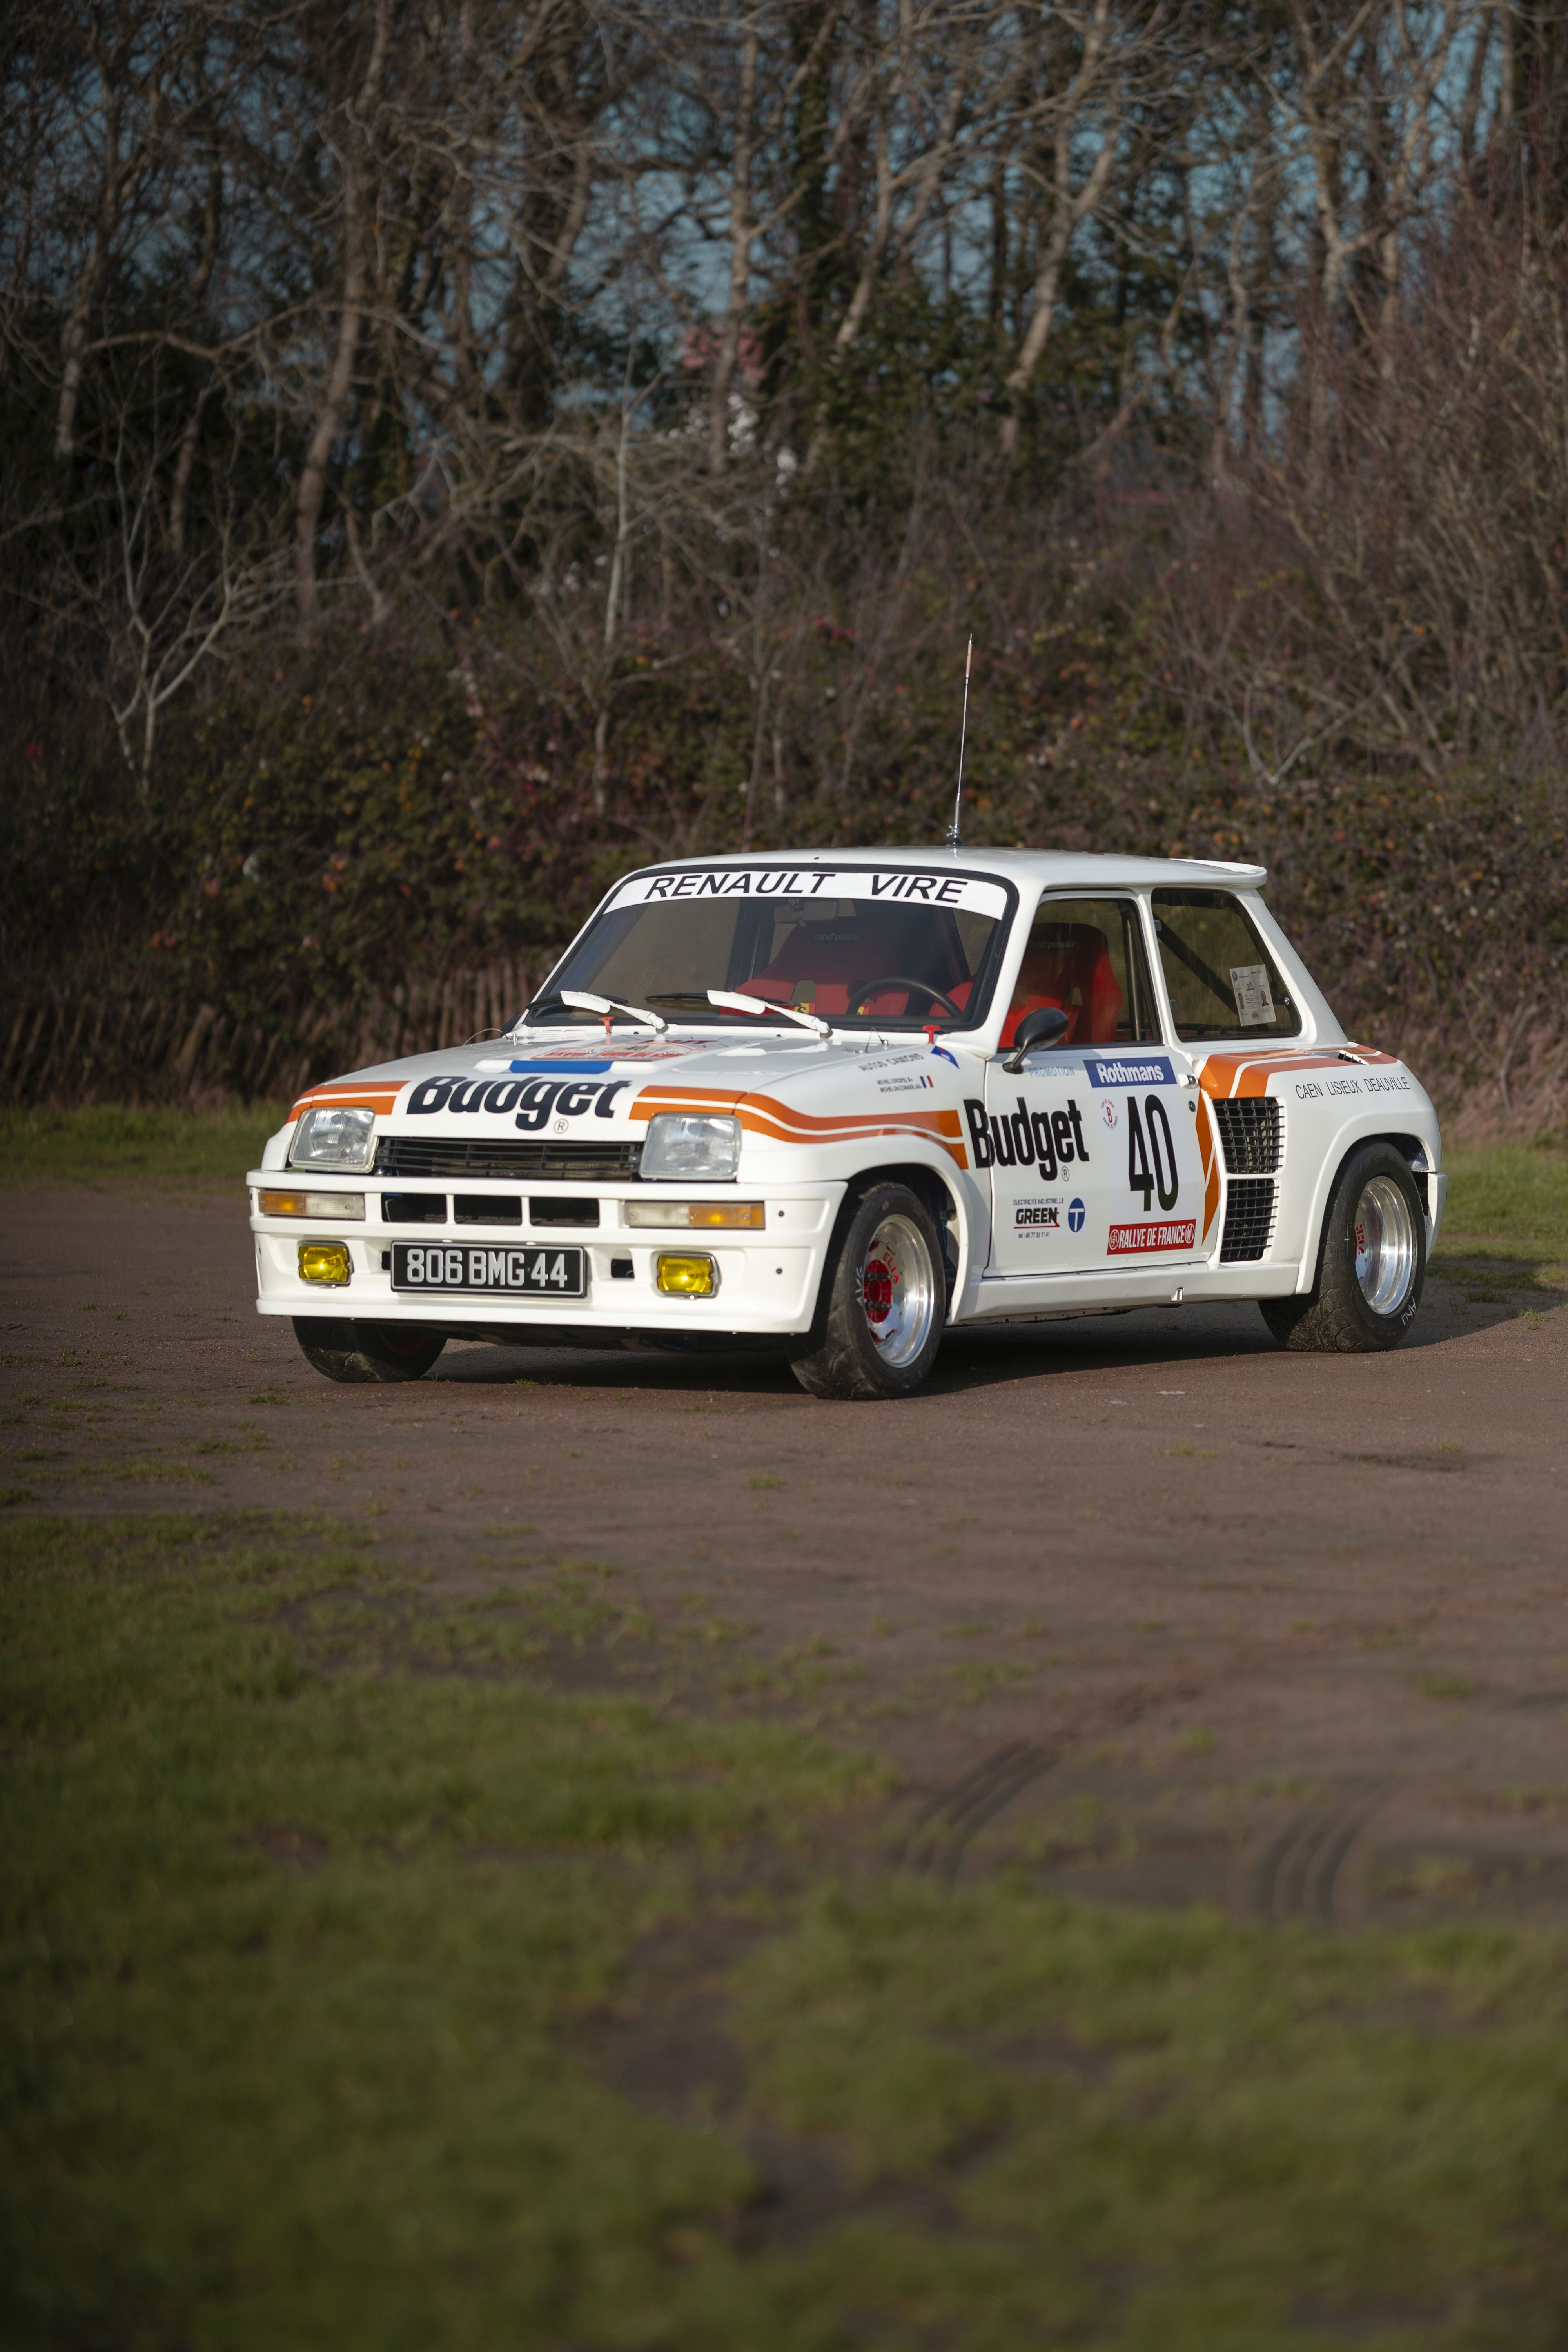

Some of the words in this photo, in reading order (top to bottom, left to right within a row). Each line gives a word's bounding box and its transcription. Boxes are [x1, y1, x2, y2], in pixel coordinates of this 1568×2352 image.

[644, 873, 836, 900] RENAULT
[871, 875, 968, 903] VIRE
[858, 1060, 887, 1071] AUTOS
[886, 1053, 924, 1065] CAMIONS
[1028, 1066, 1075, 1078] PROMOTION
[1095, 1062, 1164, 1083] Rothmans
[1296, 1083, 1323, 1099] CAEN
[1326, 1080, 1362, 1095] LISIEUX
[1363, 1077, 1410, 1092] DEAUVILLE
[406, 1076, 633, 1131] Budget
[1106, 1107, 1112, 1123] B
[963, 1097, 1090, 1181] Budget
[1127, 1094, 1179, 1212] 40
[1016, 1207, 1058, 1224] GREEN
[1118, 1228, 1146, 1249] RALLYE
[1146, 1228, 1157, 1247] DE
[1157, 1225, 1186, 1245] FRANCE
[407, 1249, 463, 1285] 806
[470, 1250, 525, 1286] BMG
[531, 1252, 568, 1288] 44
